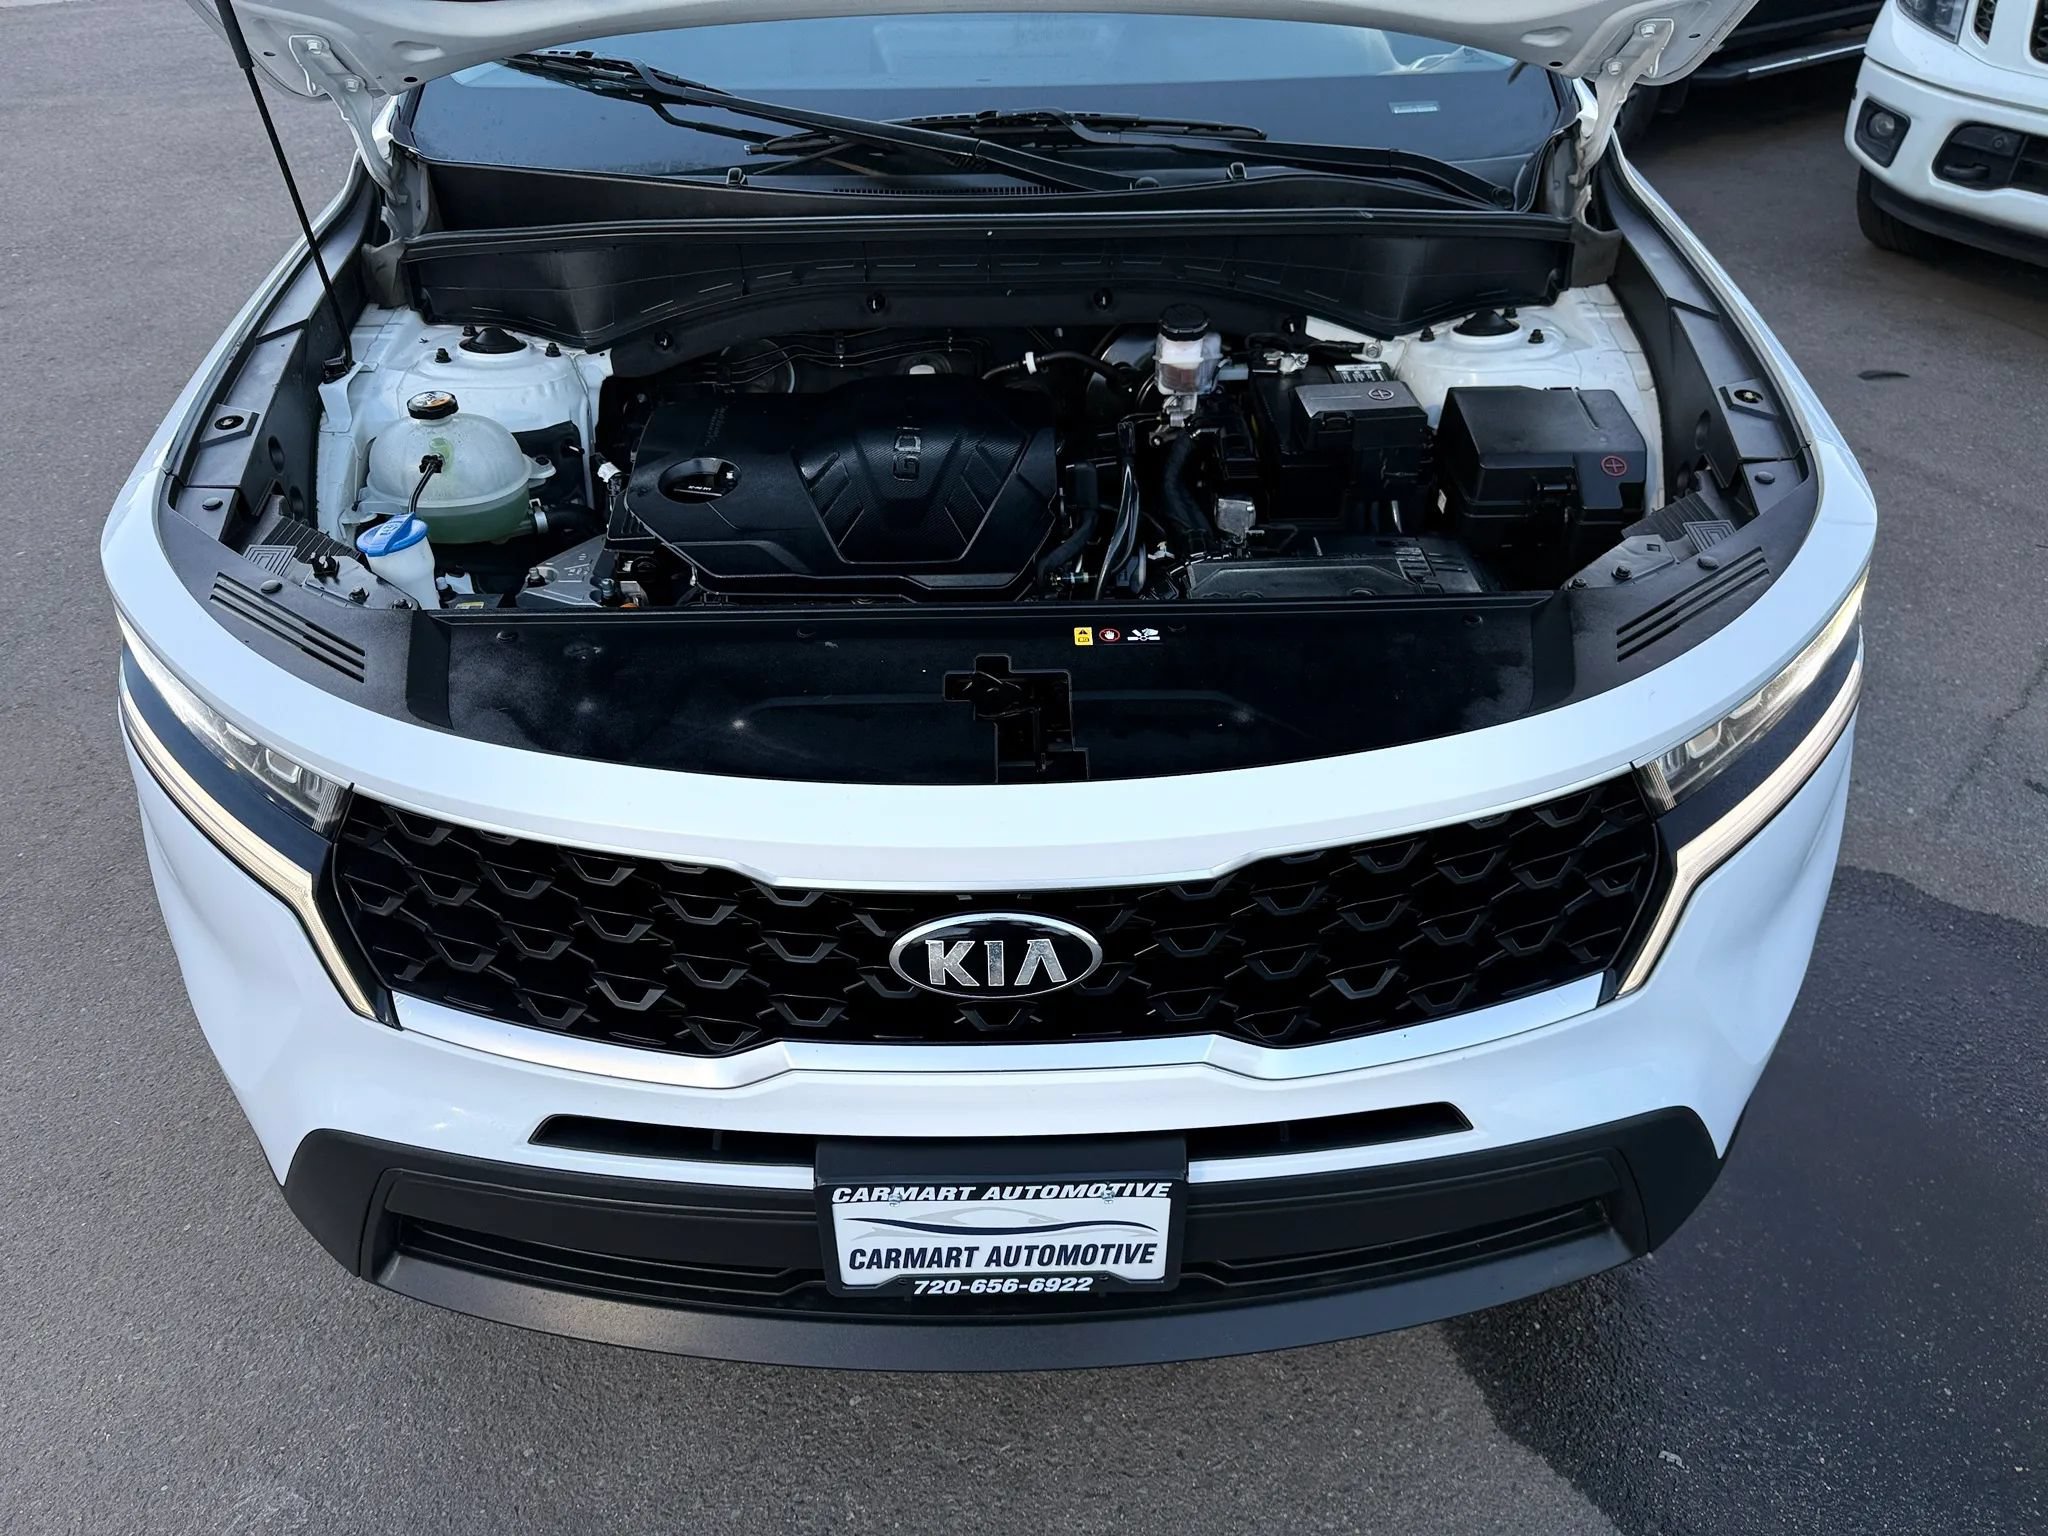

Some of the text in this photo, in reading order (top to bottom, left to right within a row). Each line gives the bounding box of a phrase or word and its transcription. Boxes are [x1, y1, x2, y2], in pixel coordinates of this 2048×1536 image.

[925, 939, 1068, 987] KIA
[832, 1182, 1173, 1203] CARMART AUTOMOTIVE
[849, 1243, 1158, 1270] CARMART AUTOMOTIVE
[913, 1277, 1094, 1295] 720-656-6922
